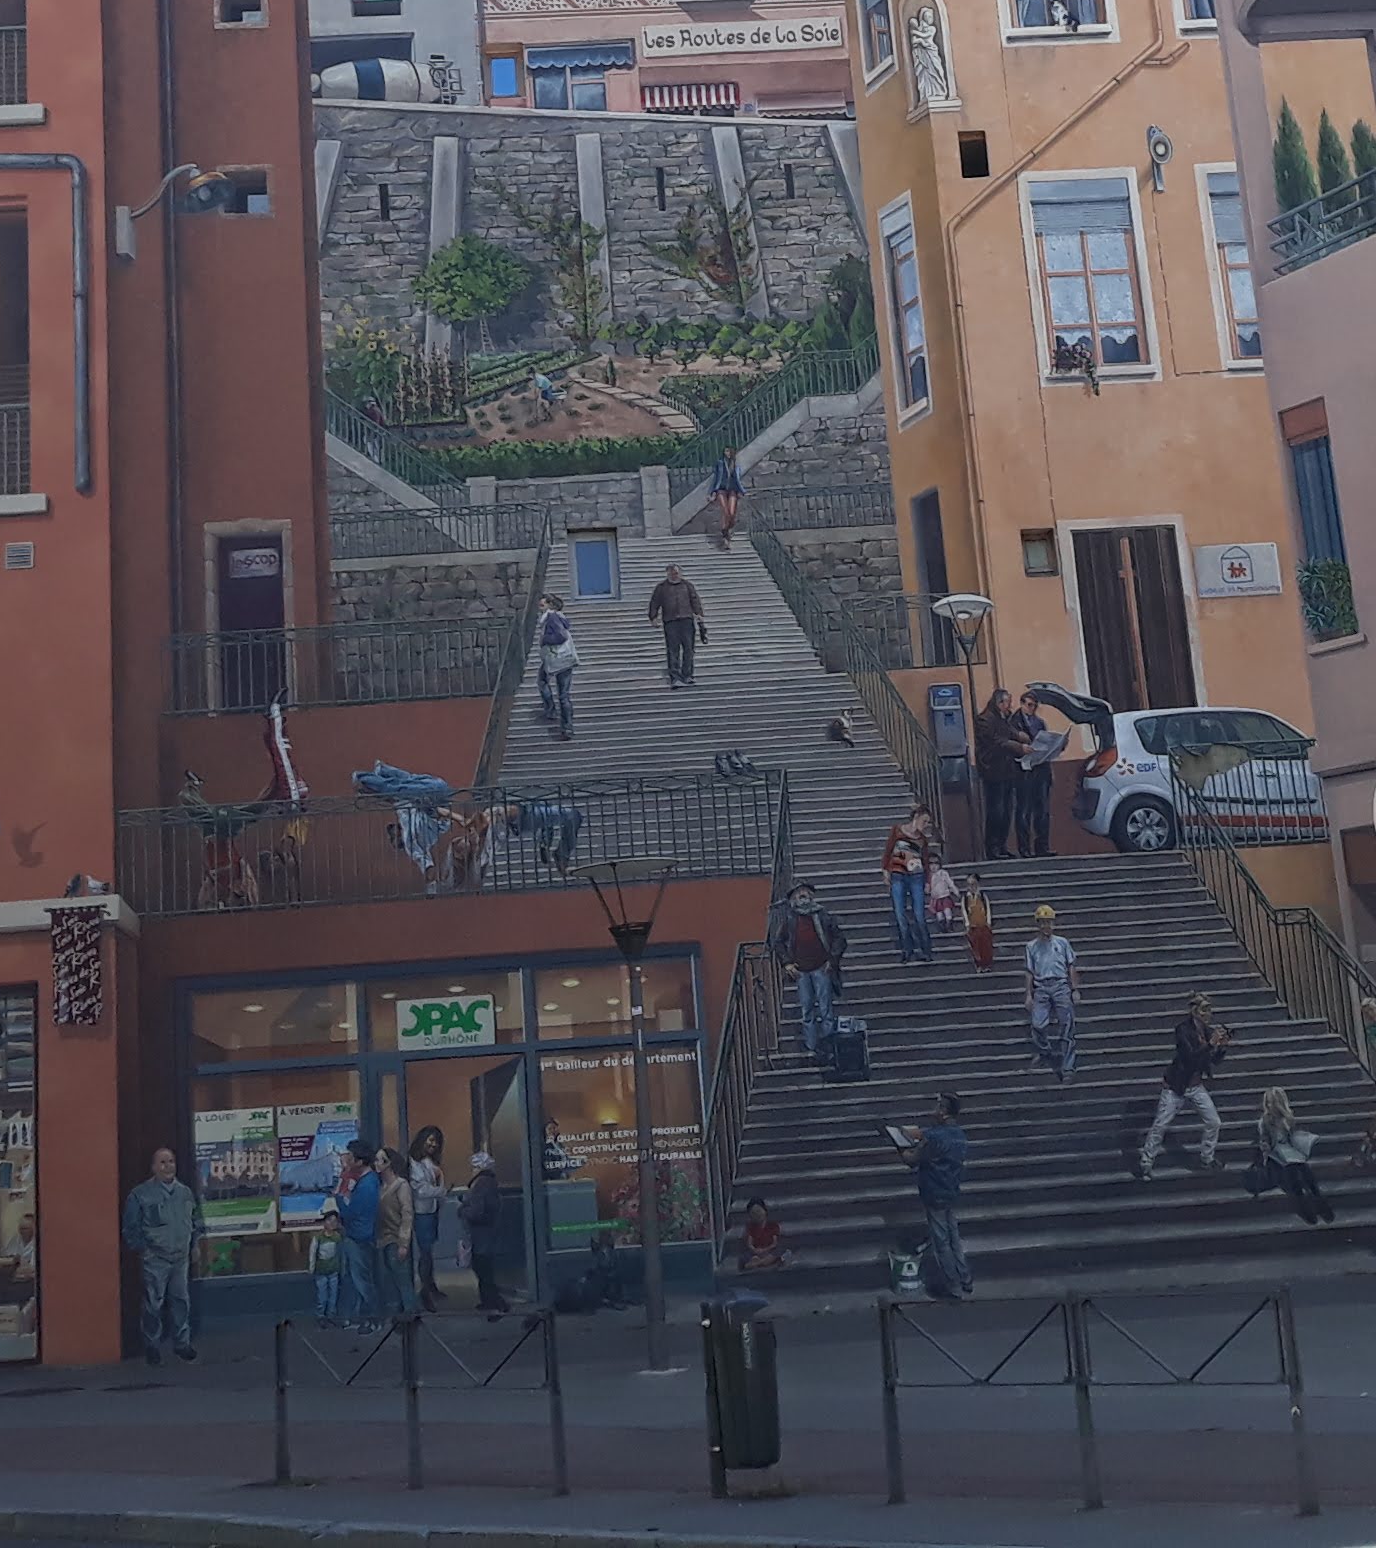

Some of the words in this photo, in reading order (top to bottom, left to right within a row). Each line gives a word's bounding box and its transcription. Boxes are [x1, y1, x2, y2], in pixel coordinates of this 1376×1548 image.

[679, 28, 745, 47] Routes
[750, 26, 771, 44] de
[800, 22, 840, 43] Soie
[556, 1058, 600, 1071] bailleur
[603, 1056, 618, 1067] du
[288, 1105, 325, 1116] VENDRE
[597, 1130, 611, 1140] DE
[612, 1129, 638, 1139] SERVI
[572, 1142, 638, 1155] CONSTRUCTEU
[660, 1150, 702, 1161] DURABLE
